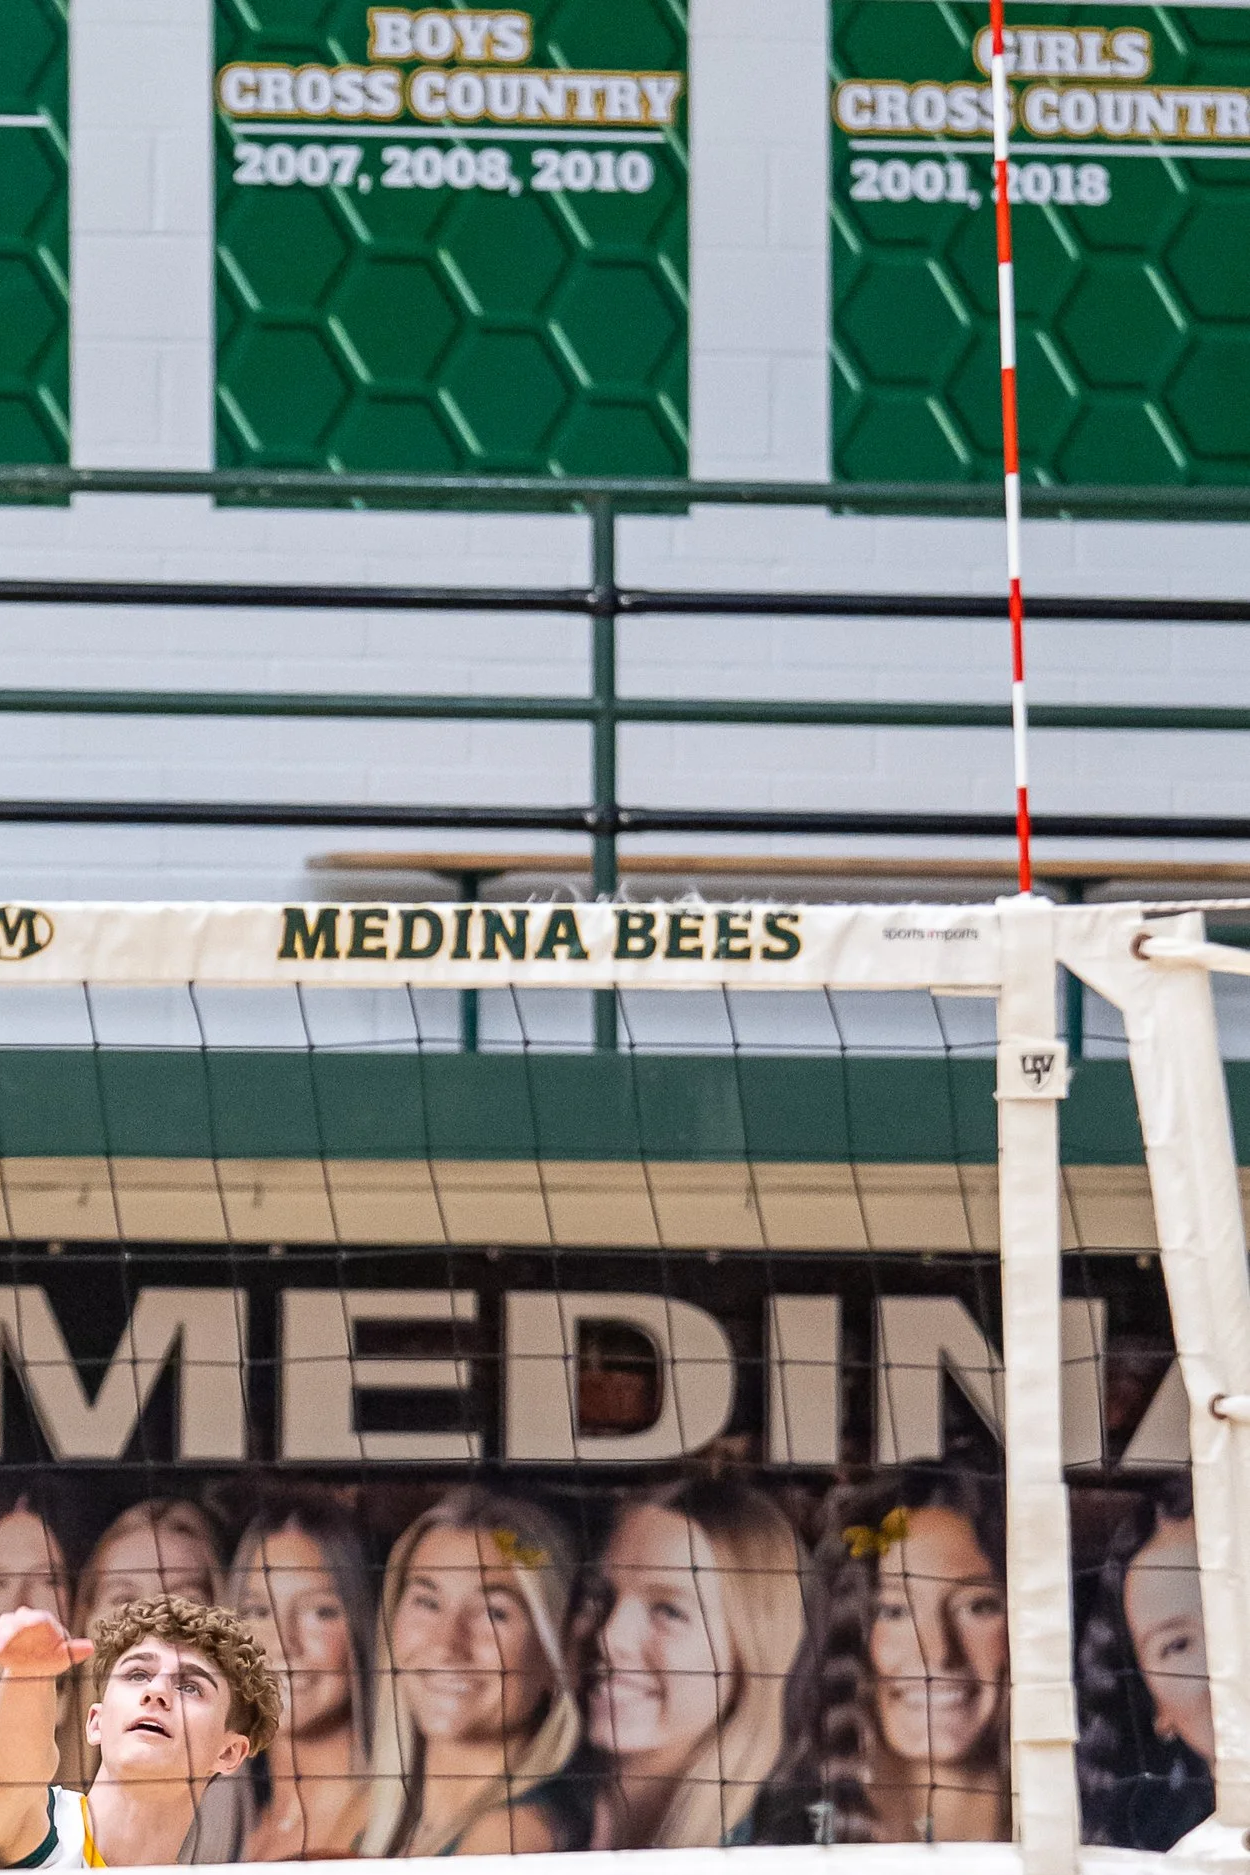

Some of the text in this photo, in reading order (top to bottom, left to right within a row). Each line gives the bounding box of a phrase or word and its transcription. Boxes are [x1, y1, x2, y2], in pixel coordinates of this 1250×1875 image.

[367, 7, 533, 62] BOYS
[973, 25, 1151, 82] GIRLS
[218, 62, 682, 125] CROSS COUNTRY
[833, 80, 1017, 136] CROSS
[233, 142, 653, 197] 2007, 2008, 2010
[850, 159, 1111, 210] 2001, 2018
[276, 906, 803, 963] MEDINA BEES
